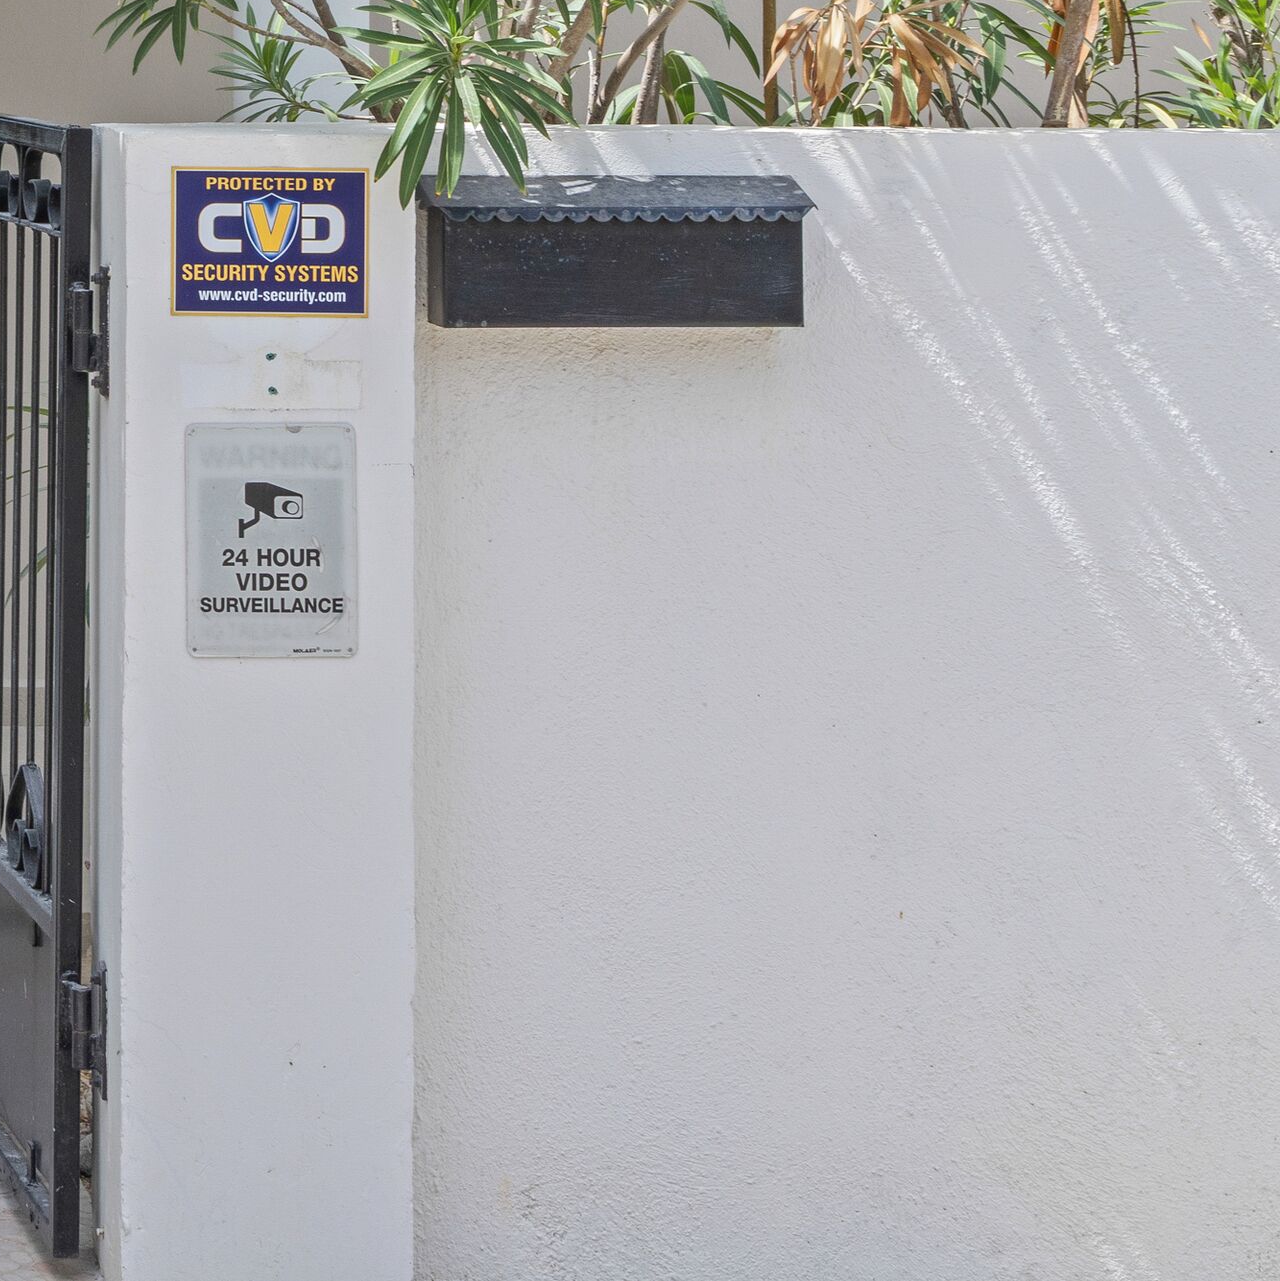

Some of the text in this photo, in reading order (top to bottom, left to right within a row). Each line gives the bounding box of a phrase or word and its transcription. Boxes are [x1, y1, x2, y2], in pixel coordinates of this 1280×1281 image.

[206, 177, 336, 191] PROTECTED BY
[197, 201, 346, 255] CVD
[181, 264, 359, 283] SECURITY SYSTEMS
[198, 288, 346, 304] www.cvd-security.com
[222, 549, 321, 567] 24 HOUR
[236, 573, 308, 591] VIDEO
[200, 598, 344, 613] SURVEILLANCE
